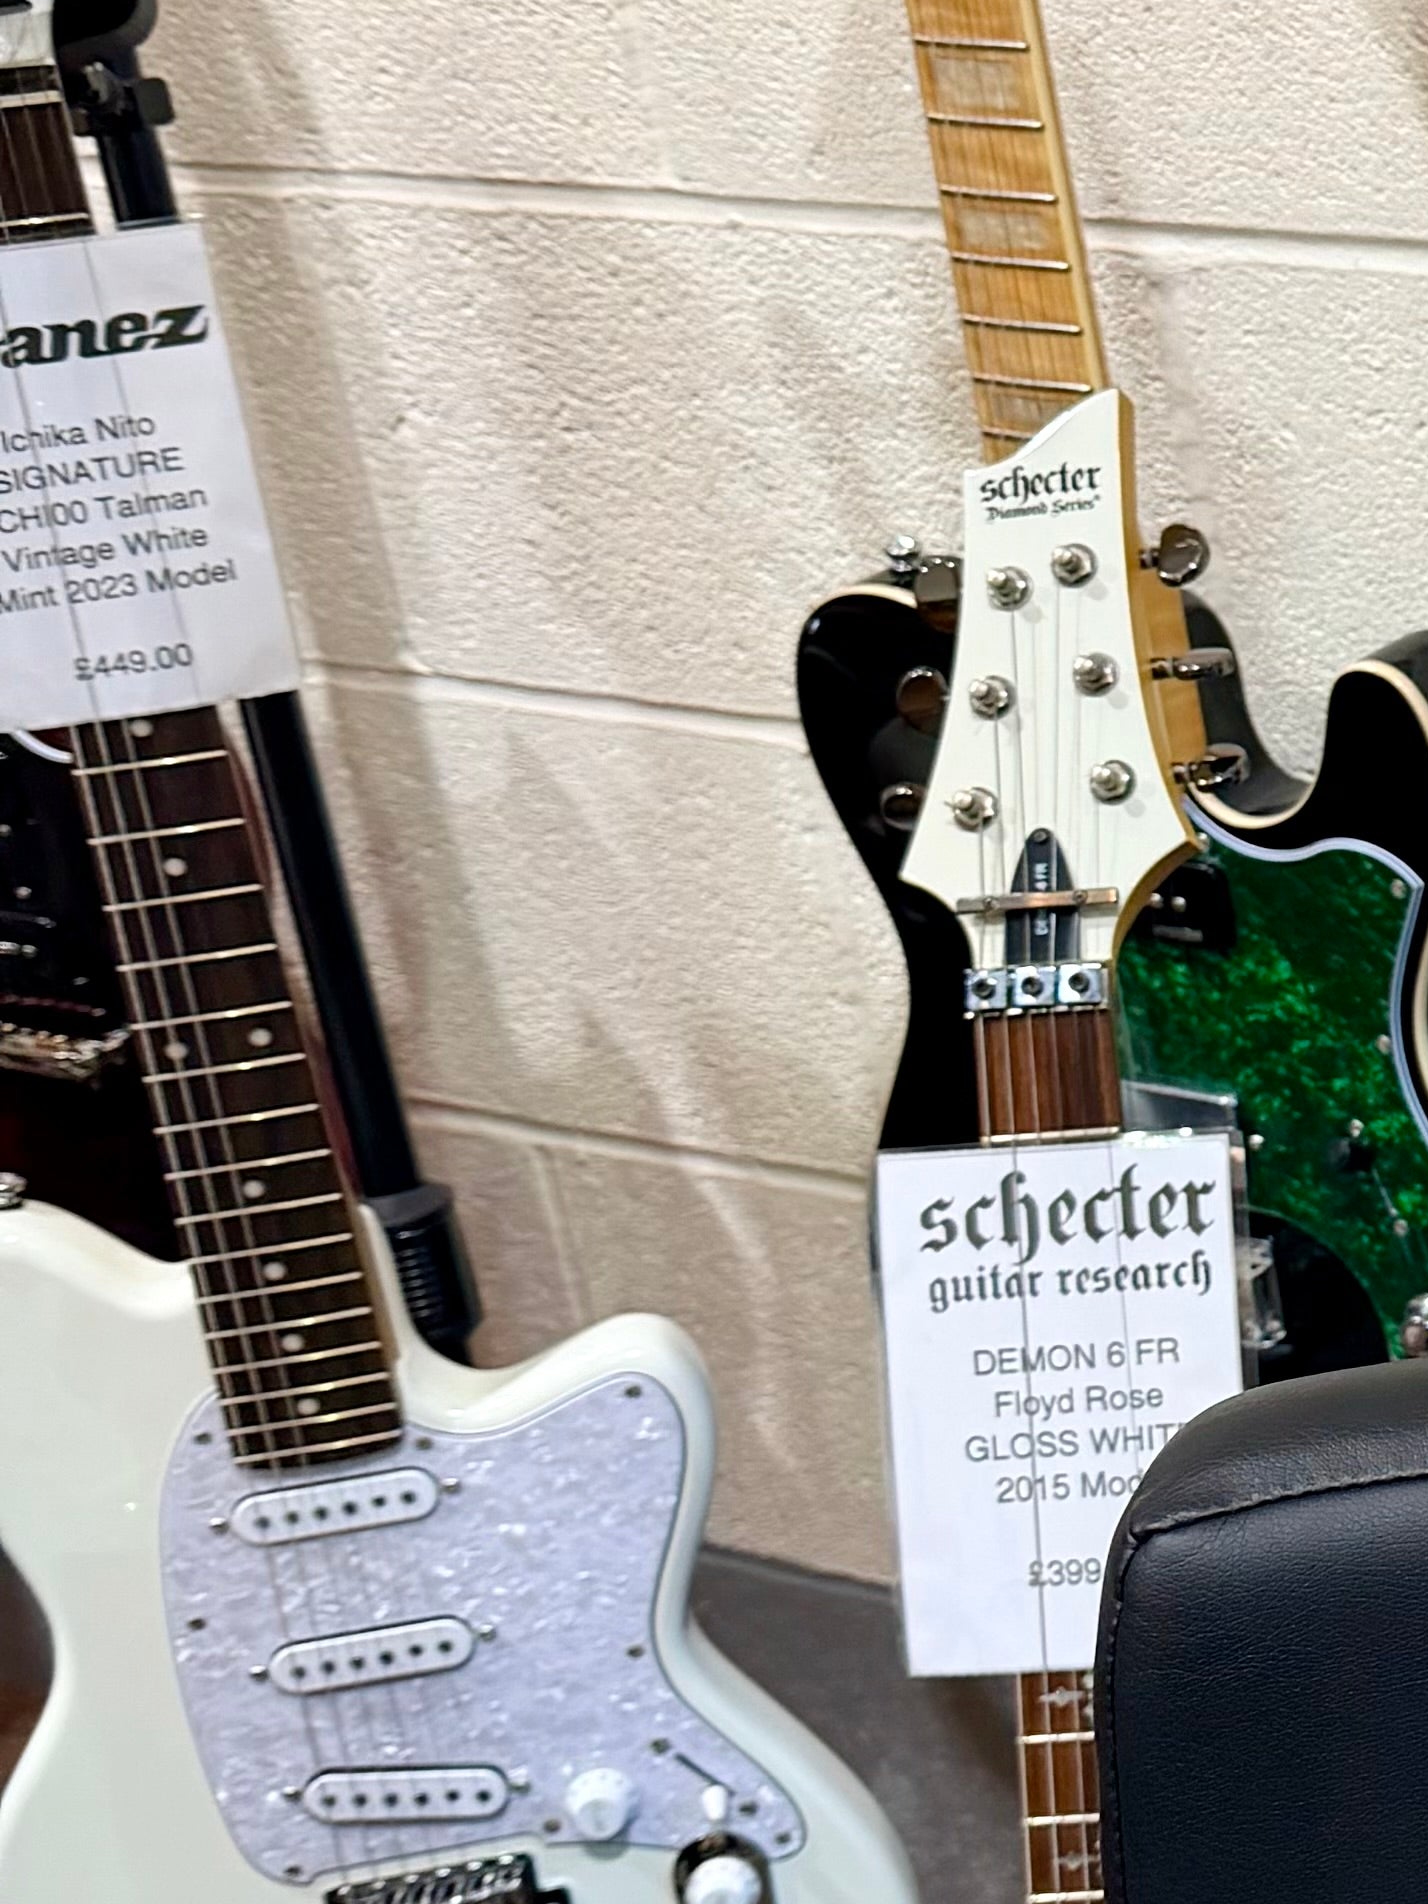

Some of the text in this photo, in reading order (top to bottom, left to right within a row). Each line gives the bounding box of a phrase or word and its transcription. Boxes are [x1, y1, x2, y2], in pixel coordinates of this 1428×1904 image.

[0, 304, 209, 369] anez
[94, 415, 156, 442] Nito
[979, 462, 1101, 506] schecter
[93, 488, 209, 521] Talman
[1, 526, 209, 572] Vintage White
[66, 573, 139, 604] 2023
[145, 558, 238, 593] Model
[74, 642, 194, 682] £449.00
[918, 1162, 1218, 1266] schecter
[928, 1249, 1214, 1314] guitar research
[973, 1336, 1181, 1376] DEMON 6 FR
[994, 1384, 1164, 1422] Floyd Rose
[964, 1422, 1185, 1463] GLOSS WHIT
[996, 1472, 1071, 1504] 2015
[1028, 1557, 1102, 1588] £399
